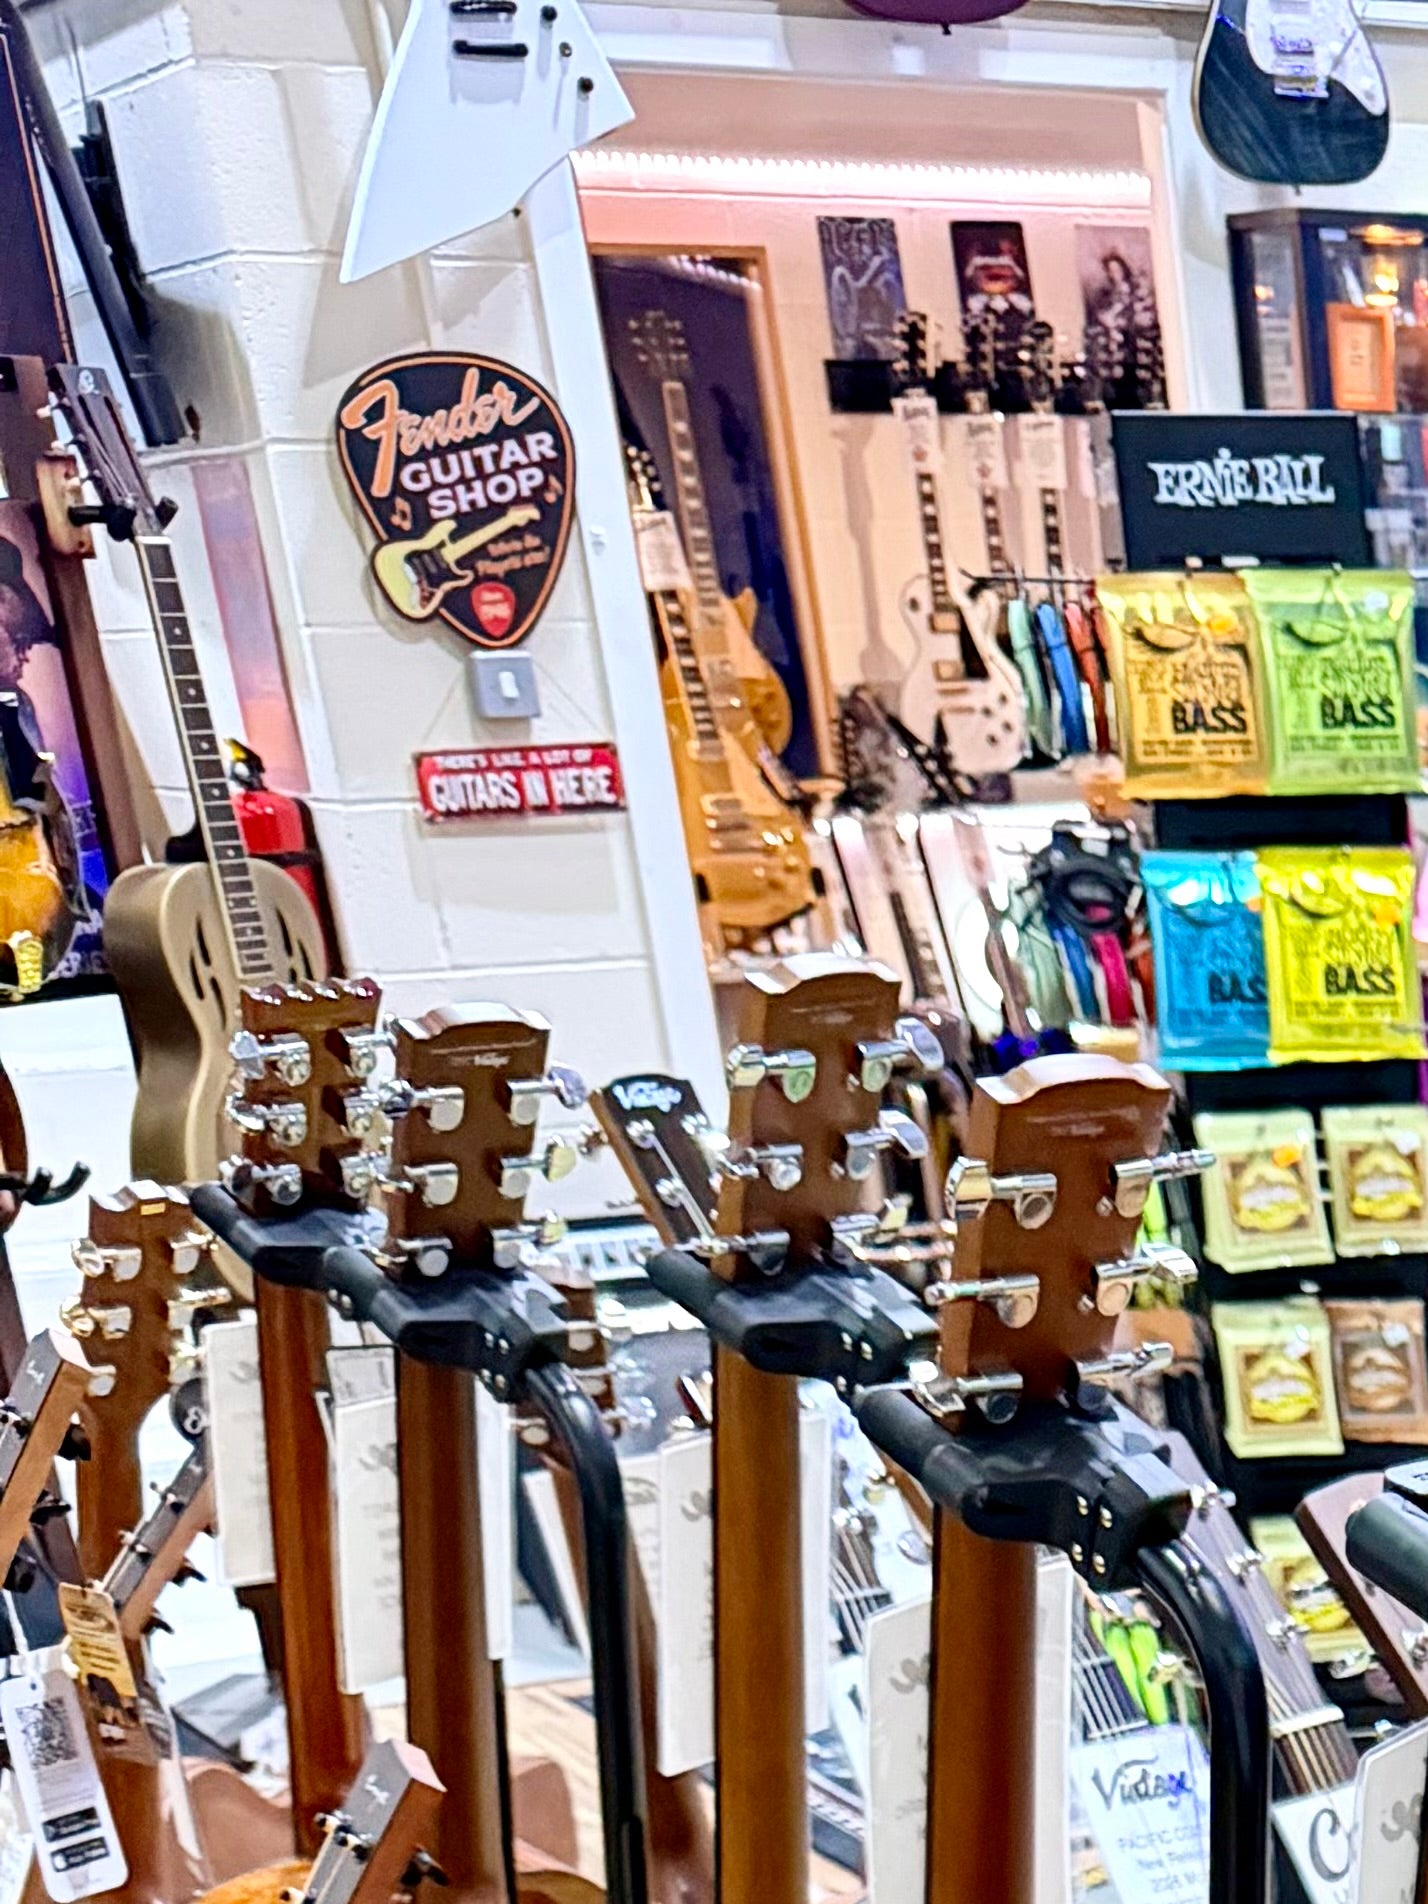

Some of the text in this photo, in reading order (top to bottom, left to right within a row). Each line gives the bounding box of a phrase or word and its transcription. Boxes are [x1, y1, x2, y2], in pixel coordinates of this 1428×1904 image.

[341, 367, 541, 498] Fender
[400, 431, 558, 492] GUITAR
[1252, 454, 1336, 505] BALL
[427, 467, 545, 520] SHOP
[1171, 701, 1248, 735] BASS
[1320, 698, 1397, 729] BASS
[428, 772, 521, 813] GUITARS
[551, 766, 617, 805] HERE
[1207, 970, 1268, 1003] BAS
[1323, 965, 1397, 997] BASS
